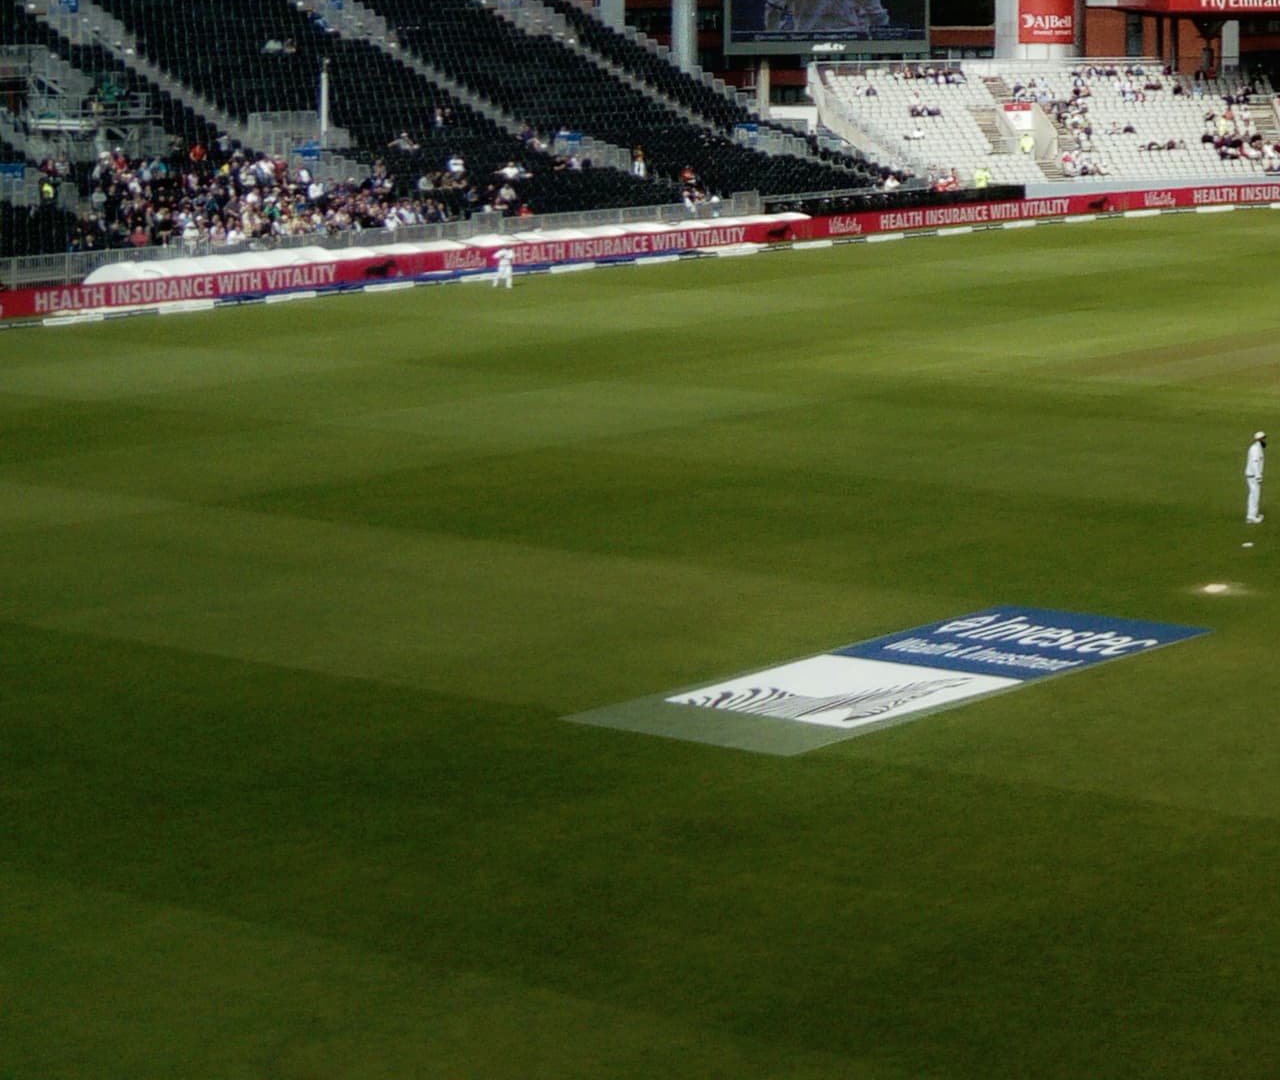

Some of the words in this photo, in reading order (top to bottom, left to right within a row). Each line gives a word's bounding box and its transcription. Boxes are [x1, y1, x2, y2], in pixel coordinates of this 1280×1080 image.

[1193, 186, 1237, 203] HEALTH
[880, 213, 923, 230] HEALTH
[925, 207, 988, 225] INSURANCE
[990, 203, 1019, 220] WITH
[1021, 199, 1069, 217] VITALITY
[443, 250, 487, 269] Vitality
[511, 245, 566, 265] HEALTH
[569, 236, 648, 260] INSURANCE
[650, 231, 687, 252] WITH
[688, 227, 747, 247] VITALITY
[34, 286, 106, 313] HEALTH
[110, 276, 213, 305] INSURANCE
[218, 270, 262, 294] WITH
[265, 264, 337, 289] VITALITY
[955, 616, 1159, 656] Investec
[962, 647, 1084, 671] Investment
